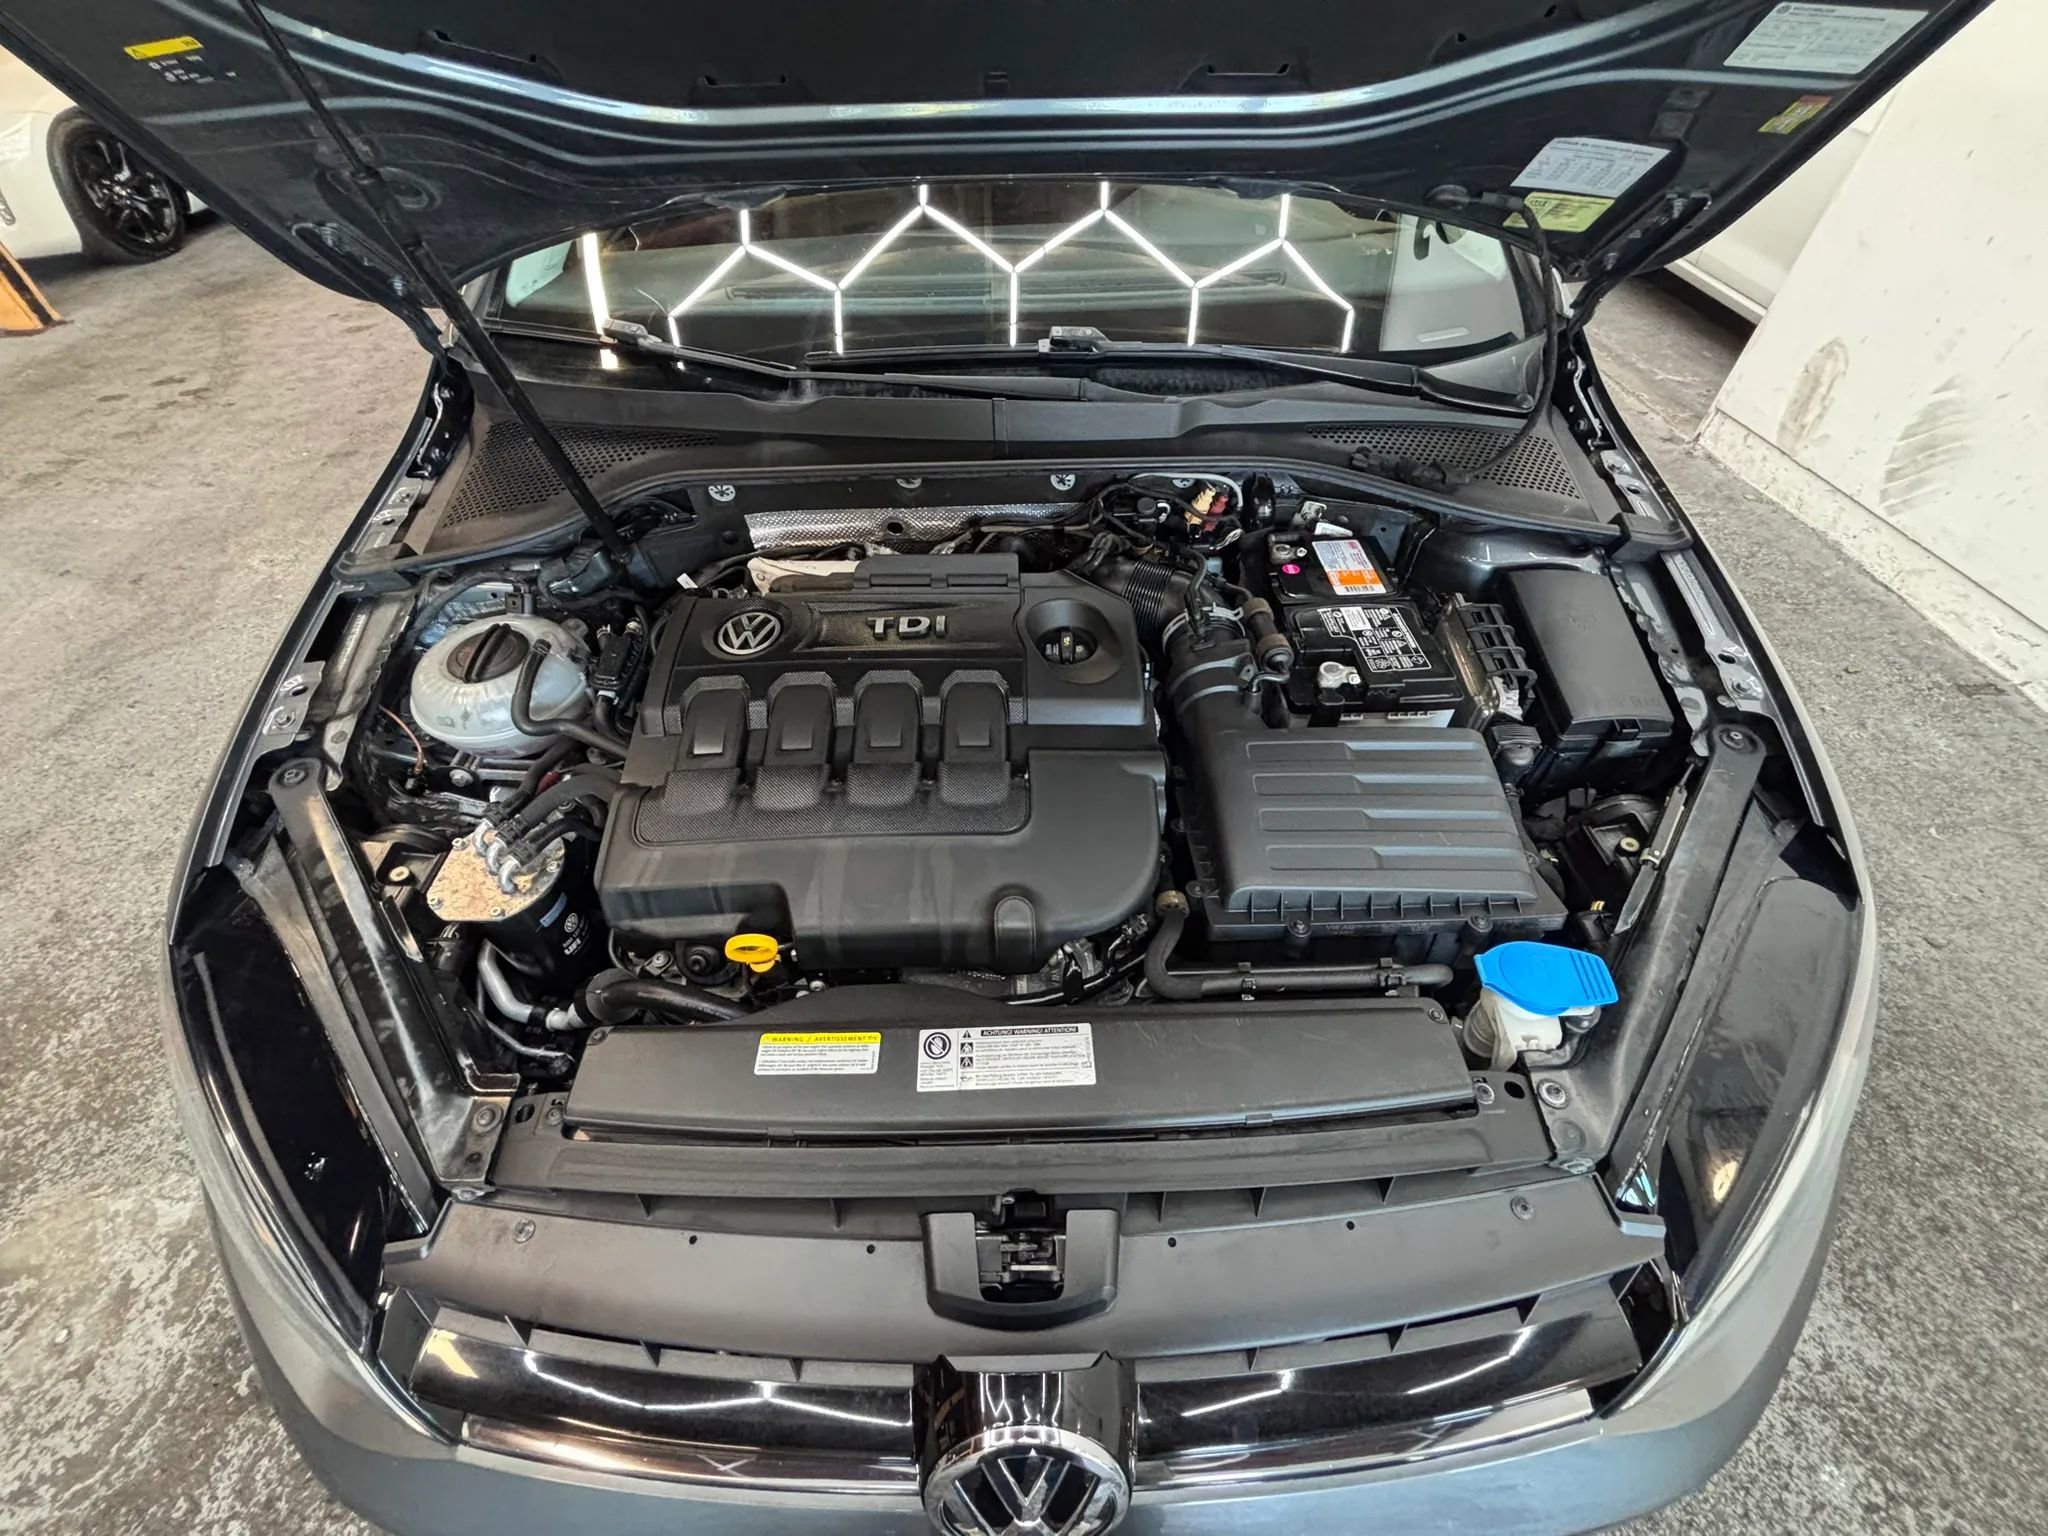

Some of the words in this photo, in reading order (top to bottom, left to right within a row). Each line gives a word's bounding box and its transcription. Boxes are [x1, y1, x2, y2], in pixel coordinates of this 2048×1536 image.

[867, 615, 947, 640] TDI
[982, 1029, 1012, 1037] ACHTUNG!
[1013, 1027, 1042, 1036] WARNING!
[1043, 1026, 1077, 1034] ATTENTION!
